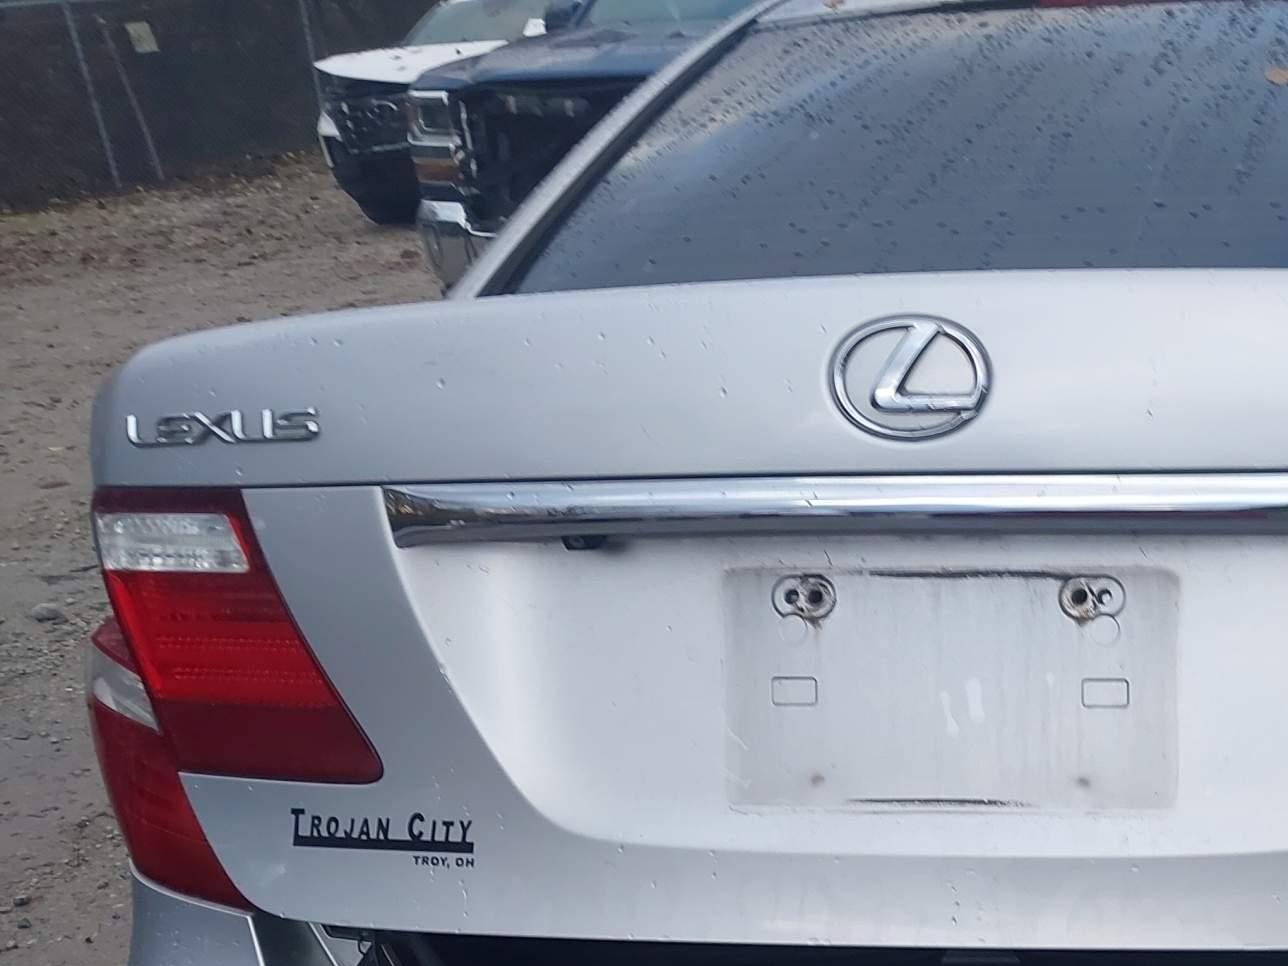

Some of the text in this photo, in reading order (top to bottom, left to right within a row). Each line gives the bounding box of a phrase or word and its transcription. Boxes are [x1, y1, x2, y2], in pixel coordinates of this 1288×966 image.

[126, 406, 320, 448] LEXUS
[291, 808, 473, 844] TROJAN CITY
[412, 855, 475, 869] TROY, OH
